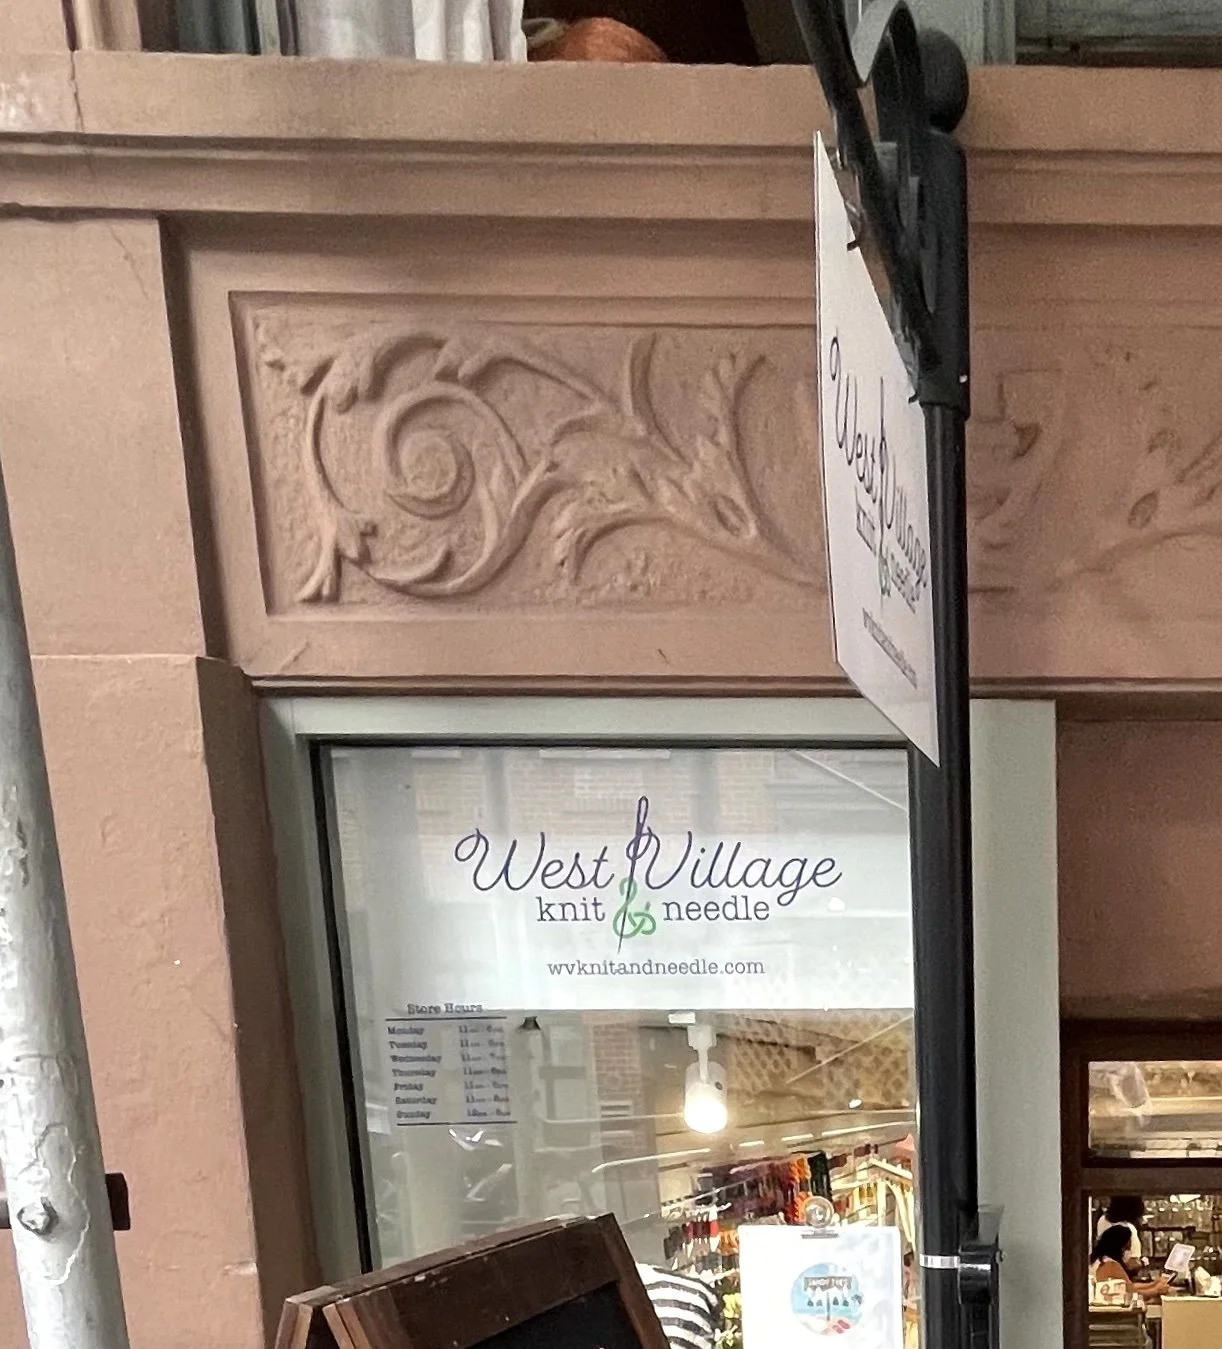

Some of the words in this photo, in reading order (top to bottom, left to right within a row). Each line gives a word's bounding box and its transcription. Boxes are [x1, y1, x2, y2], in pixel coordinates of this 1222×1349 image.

[829, 326, 878, 503] West
[879, 428, 928, 588] Village
[454, 827, 616, 892] West
[626, 825, 843, 907] Village
[535, 896, 606, 923] knit
[612, 876, 657, 940] &
[661, 895, 771, 922] needle
[547, 959, 766, 977] wvknitandneedle.com
[406, 1003, 441, 1015] Store
[444, 1001, 484, 1014] Hours
[387, 1026, 425, 1036] Monday
